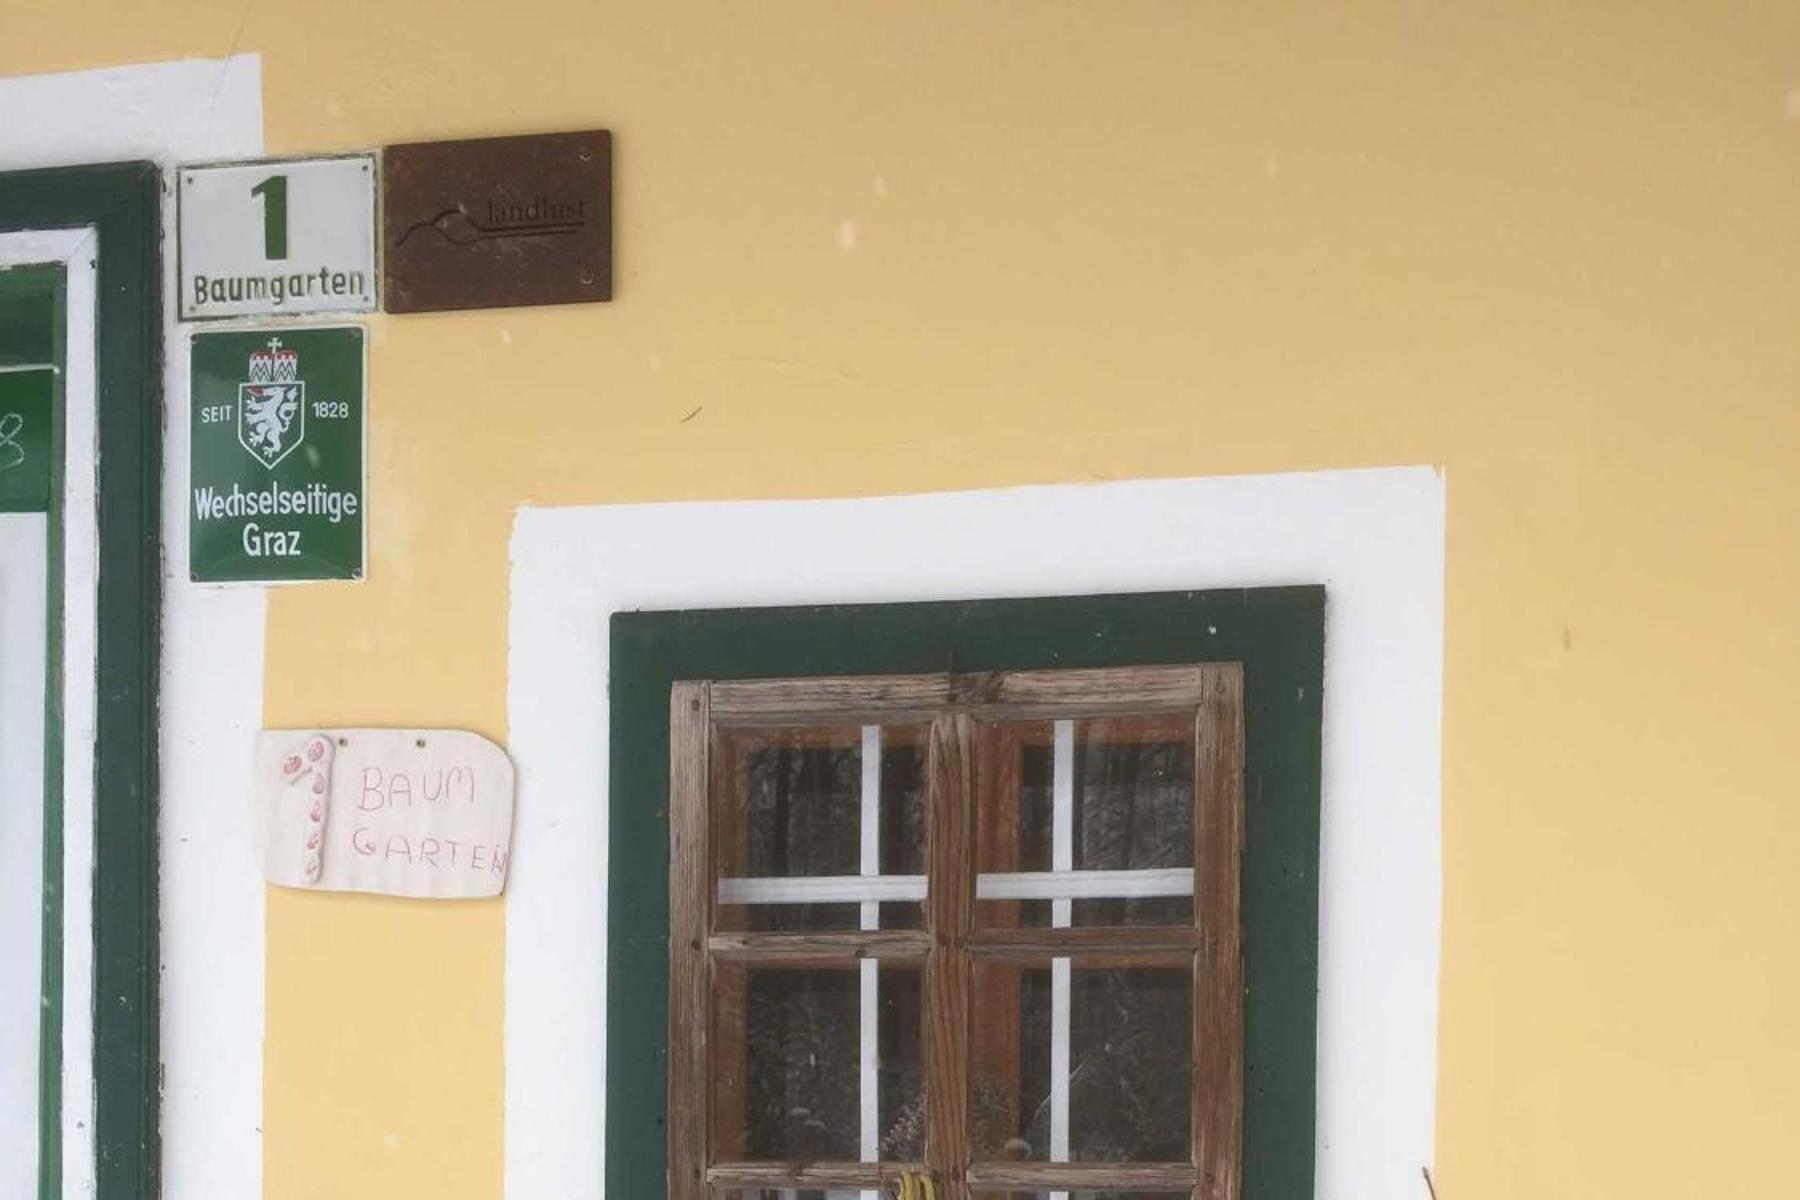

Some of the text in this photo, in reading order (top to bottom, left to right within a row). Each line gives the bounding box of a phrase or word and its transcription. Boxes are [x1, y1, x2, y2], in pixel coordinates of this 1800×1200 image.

[250, 175, 288, 260] 1
[487, 195, 586, 223] landlust
[193, 266, 365, 306] Baumgarten
[200, 400, 349, 424] SEIT 1828
[193, 481, 358, 524] Wechselseitige
[242, 522, 302, 557] Graz
[358, 766, 475, 811] BAUM
[352, 827, 511, 874] GARTEN
